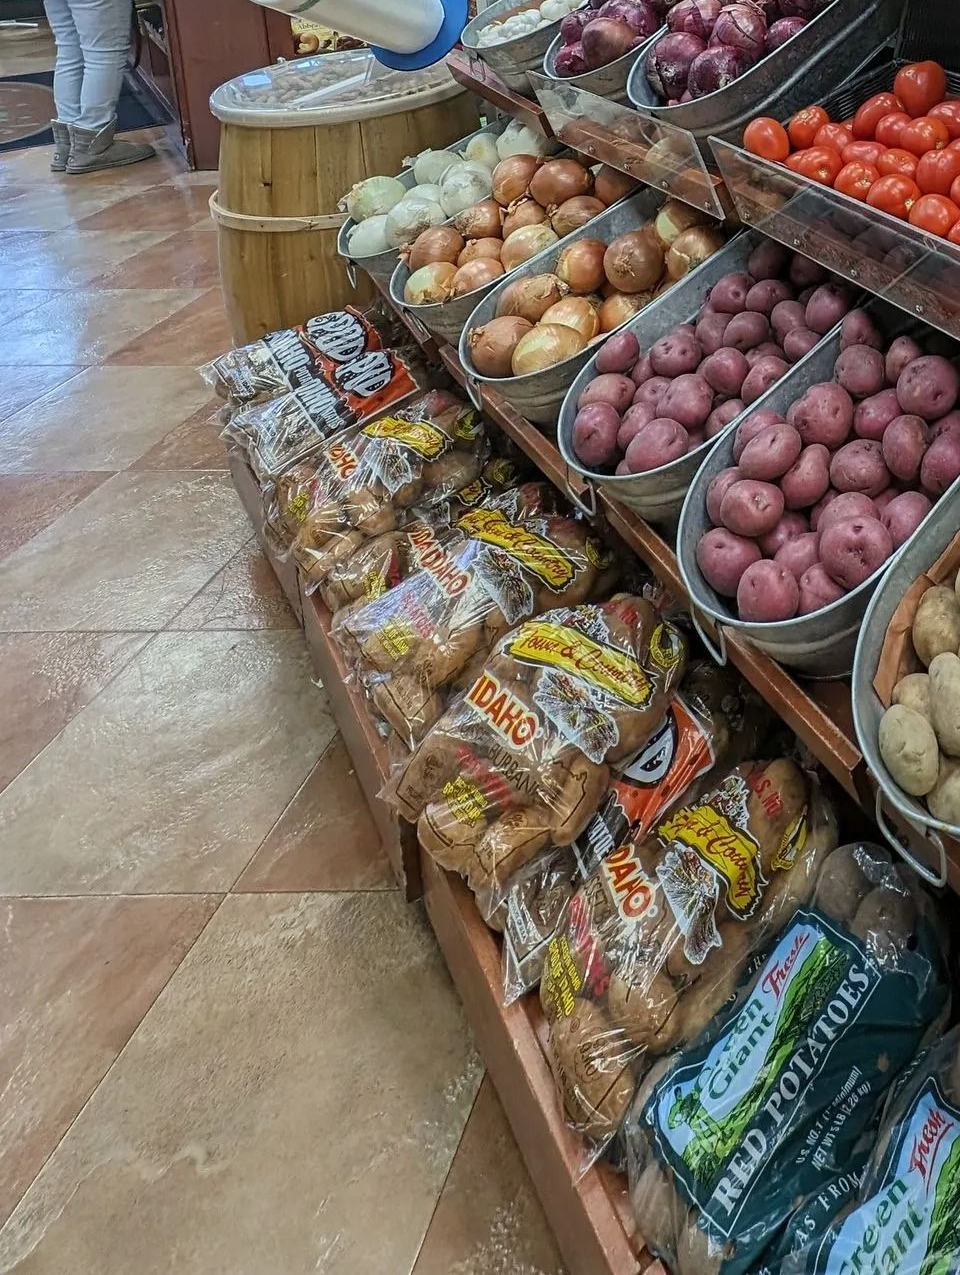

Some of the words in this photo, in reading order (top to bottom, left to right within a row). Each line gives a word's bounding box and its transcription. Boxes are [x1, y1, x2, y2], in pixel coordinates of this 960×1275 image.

[575, 649, 647, 694] Country
[469, 676, 537, 746] IDAHO
[605, 844, 652, 918] DAHO
[762, 932, 810, 1003] Fresh
[709, 1011, 776, 1100] Giant
[712, 1128, 768, 1217] RED
[763, 963, 870, 1127] POTATOES
[811, 1146, 827, 1171] NET
[907, 1108, 955, 1197] Fresh
[818, 1171, 863, 1212] FROM
